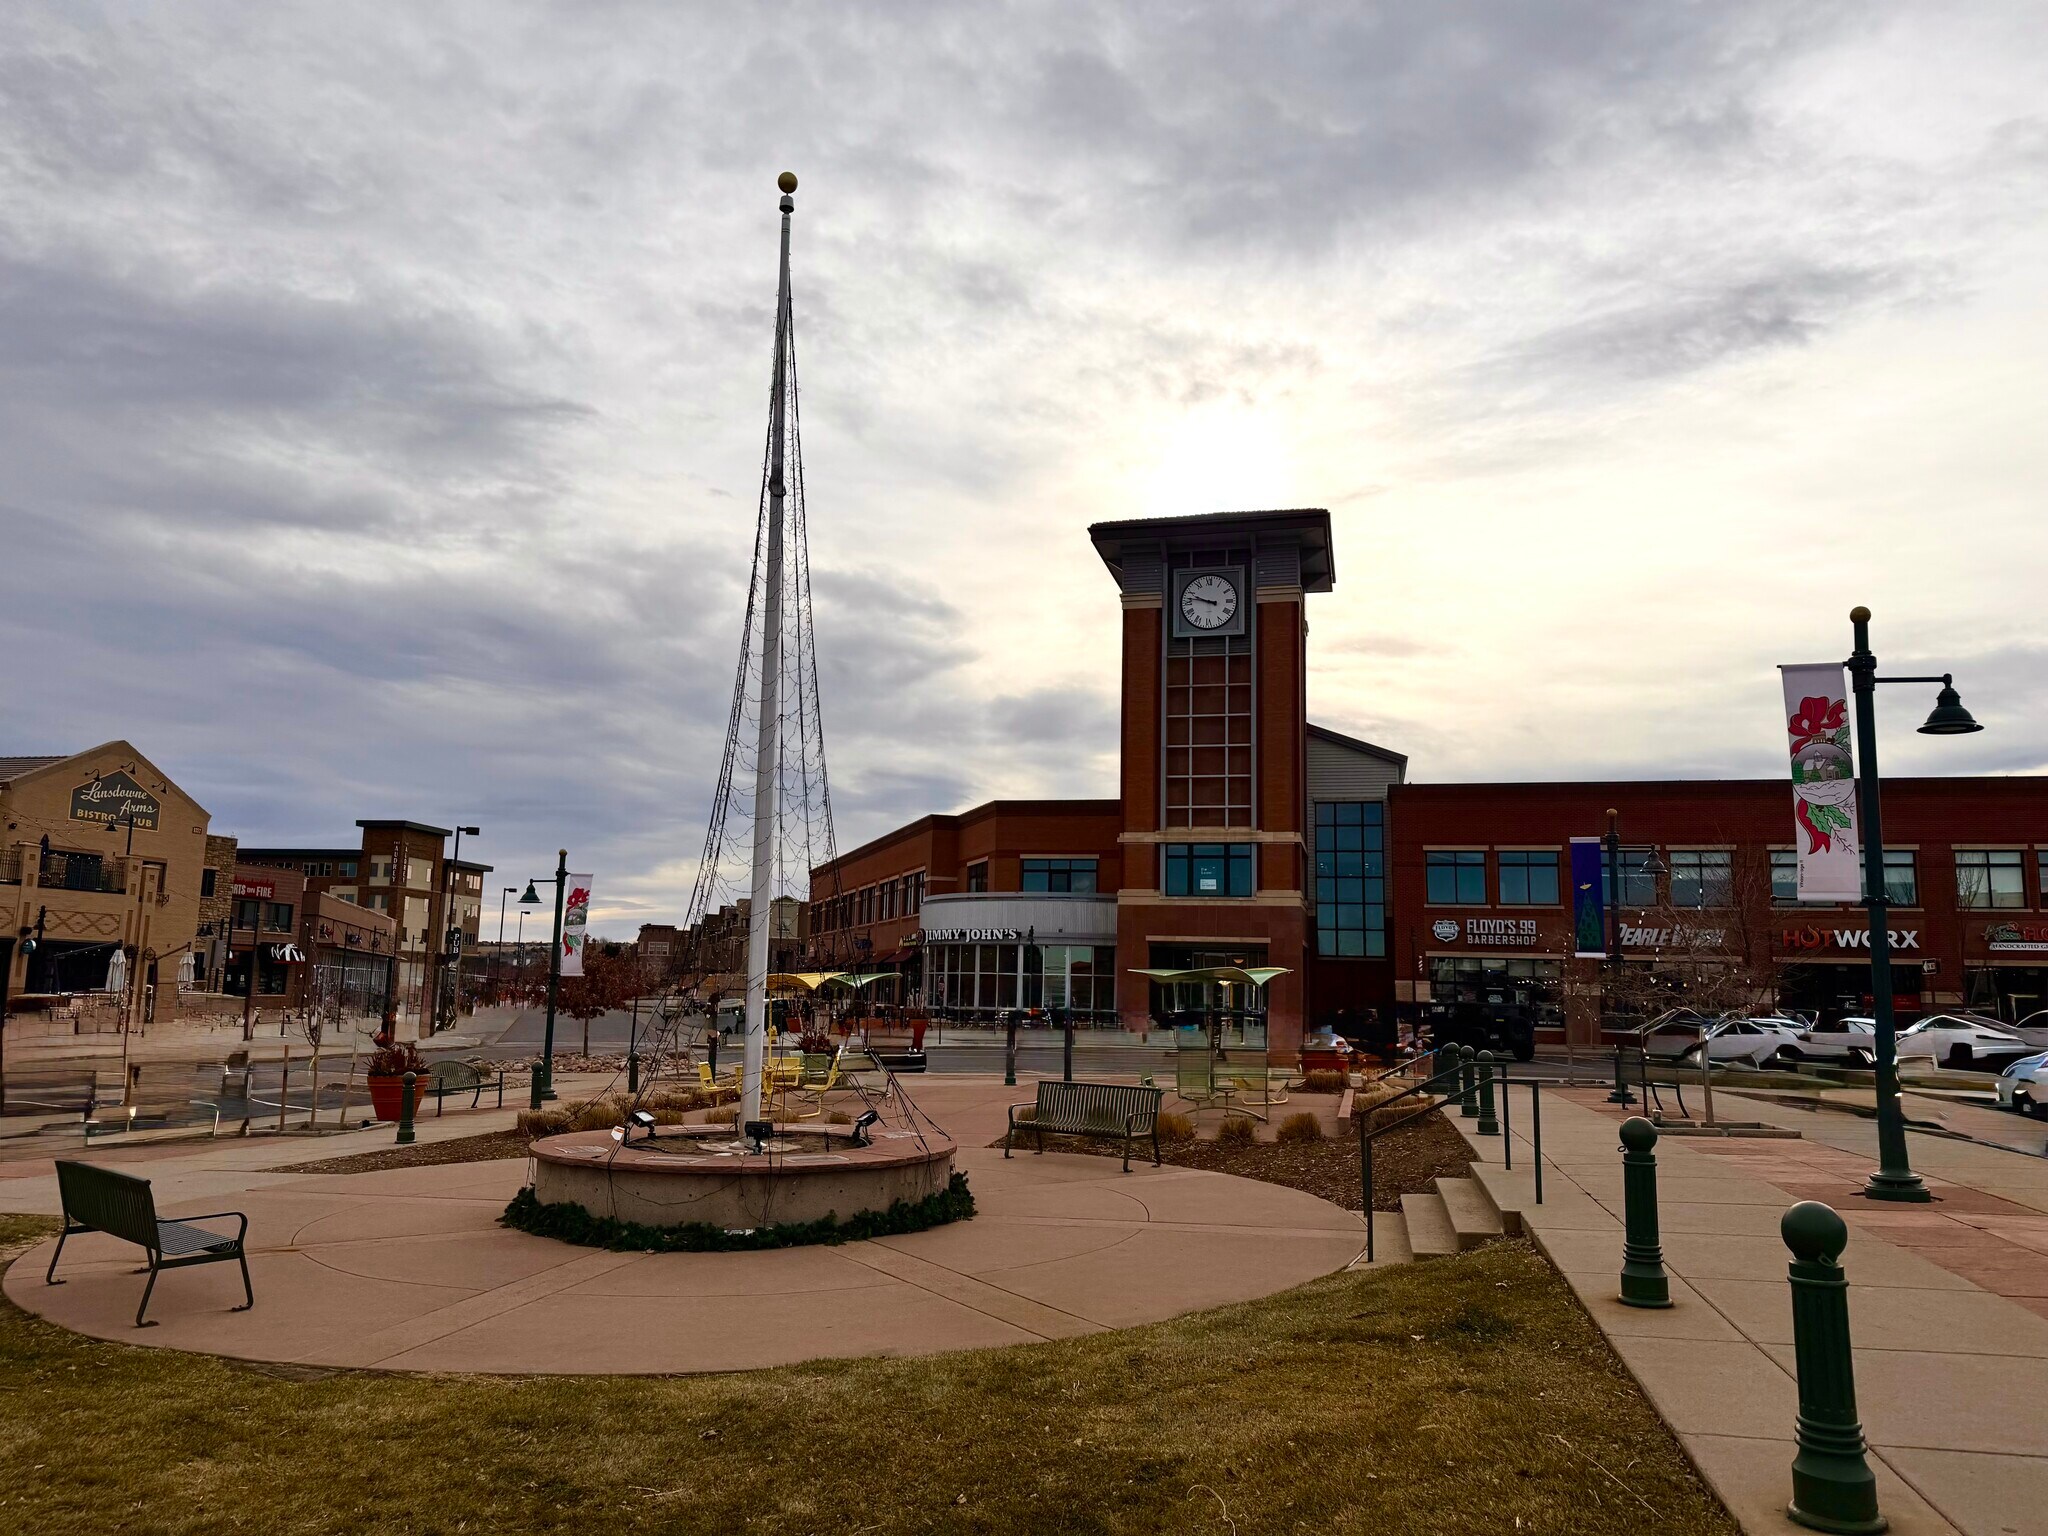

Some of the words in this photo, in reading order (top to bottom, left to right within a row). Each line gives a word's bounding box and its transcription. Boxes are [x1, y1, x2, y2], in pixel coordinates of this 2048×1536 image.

[80, 781, 148, 802] Lansdowne
[76, 808, 117, 822] BISTRO
[119, 799, 158, 817] Arms
[256, 886, 273, 898] FIRE
[1466, 919, 1517, 935] FLOYD'S
[1519, 920, 1537, 935] 99
[925, 929, 961, 943] JIMMY
[963, 928, 1018, 943] JOHN'S
[1467, 935, 1537, 946] BARBERSHOP
[452, 933, 460, 954] PUB
